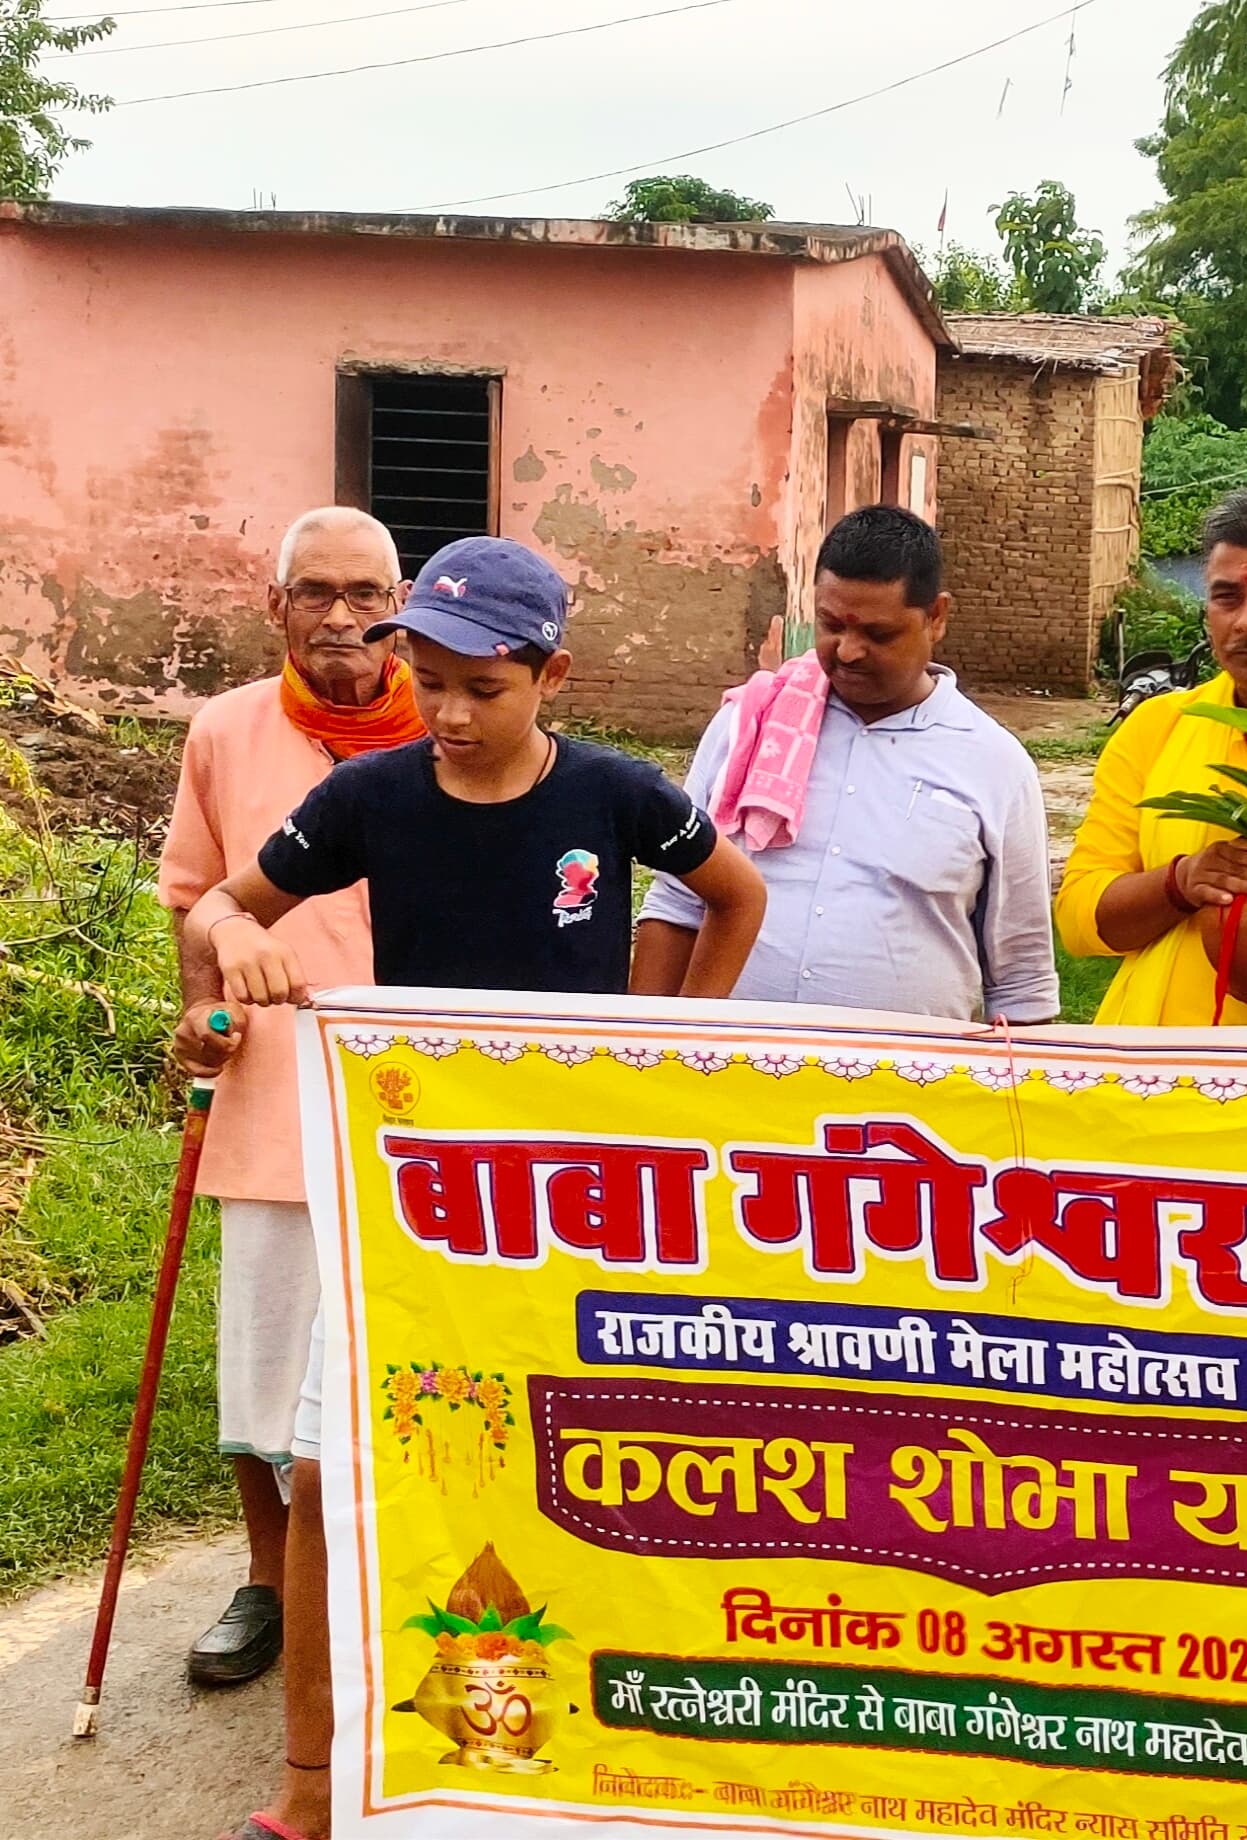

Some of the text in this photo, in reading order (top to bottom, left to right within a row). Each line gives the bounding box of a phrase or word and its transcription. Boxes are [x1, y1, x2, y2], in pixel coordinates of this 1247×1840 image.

[382, 1133, 710, 1265] बाबा
[594, 1304, 778, 1364] राजकीय
[786, 1315, 938, 1375] श्रावणी
[946, 1319, 1049, 1385] मेला
[1055, 1332, 1240, 1402] महोत्सव
[559, 1427, 854, 1524] कलश
[887, 1427, 1139, 1542] शोभा
[720, 1585, 907, 1650] दिनांक
[916, 1607, 968, 1658] 08
[980, 1619, 1166, 1675] अगस्त
[608, 1669, 647, 1717] माँ
[648, 1676, 763, 1727] रत्नेश्वरी
[770, 1678, 850, 1730] मंदिर
[854, 1684, 886, 1732] से
[892, 1696, 958, 1737] बाबा
[963, 1690, 1068, 1751] गंगेश्वर
[1073, 1715, 1137, 1757] नाथ
[859, 1794, 907, 1823] नाथ
[914, 1794, 999, 1828] महादेव
[1003, 1798, 1070, 1834] मंदिर
[1073, 1811, 1139, 1839] न्यास
